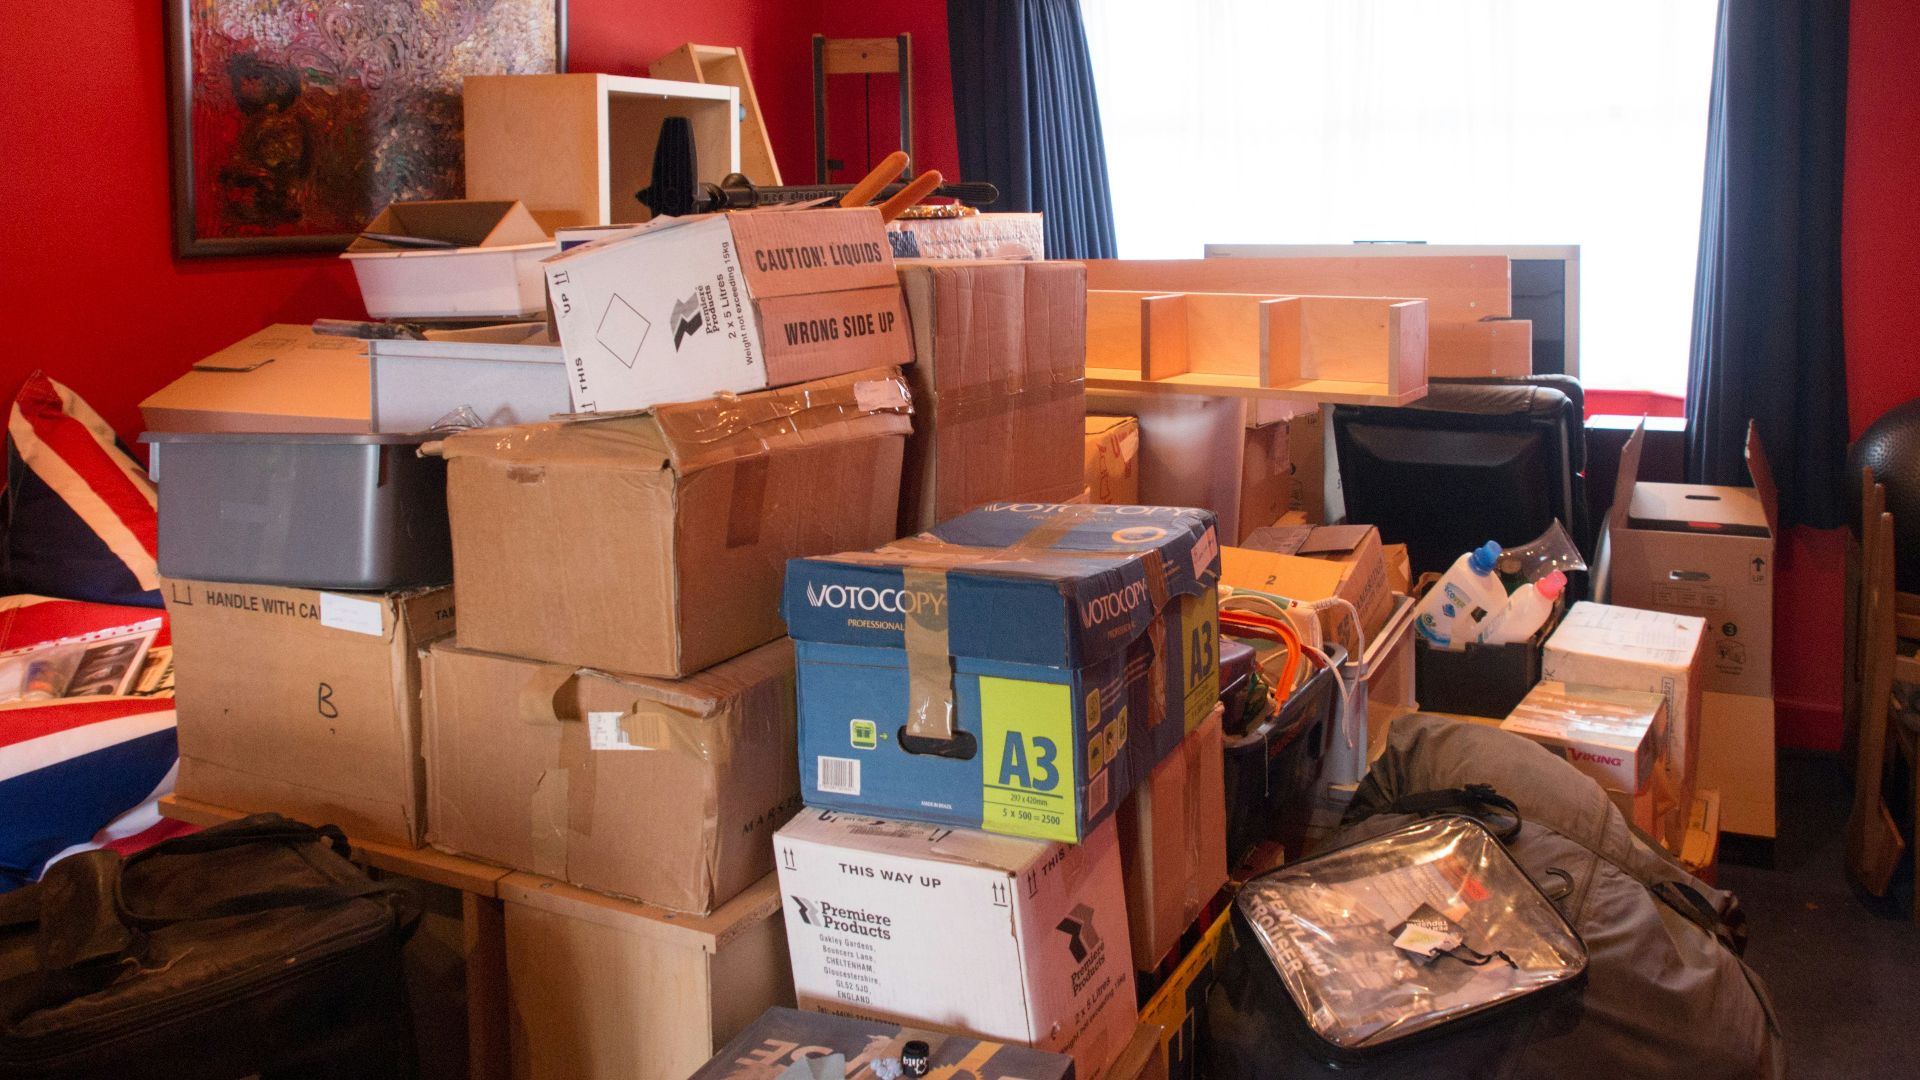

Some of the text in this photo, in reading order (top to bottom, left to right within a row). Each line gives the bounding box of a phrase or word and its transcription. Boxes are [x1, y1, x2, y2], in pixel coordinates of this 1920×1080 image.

[755, 242, 883, 272] CAUTION! LIQUIDS
[716, 273, 731, 308] Litres
[721, 241, 754, 366] Weight not exceeding 15kg
[697, 285, 714, 334] Premiere
[704, 285, 721, 333] Products
[723, 311, 732, 319] 5
[561, 293, 588, 393] THIS UP
[728, 331, 737, 340] 2
[784, 311, 895, 346] WRONG SIDE UP
[1265, 575, 1277, 585] 2
[206, 591, 258, 612] HANDLE
[261, 597, 296, 616] WITH
[299, 602, 321, 620] CA
[807, 581, 945, 615] VOTOCOPY
[1080, 578, 1147, 629] VOTOCOPY
[848, 618, 905, 631] PROFESSIONAL
[1190, 620, 1213, 689] A3
[318, 682, 338, 718] B
[998, 730, 1060, 791] A3
[1568, 748, 1622, 767] VIKING
[1002, 808, 1008, 817] 5
[1018, 811, 1032, 821] 500
[1041, 813, 1060, 825] 2500
[1010, 793, 1021, 801] 297
[1027, 796, 1048, 806] 420mm
[838, 862, 942, 889] THIS WAY UP
[820, 901, 892, 927] Premiere
[823, 915, 891, 941] Products
[1250, 894, 1304, 978] TROUSER
[1071, 941, 1105, 985] Premiere
[1073, 956, 1106, 997] Products
